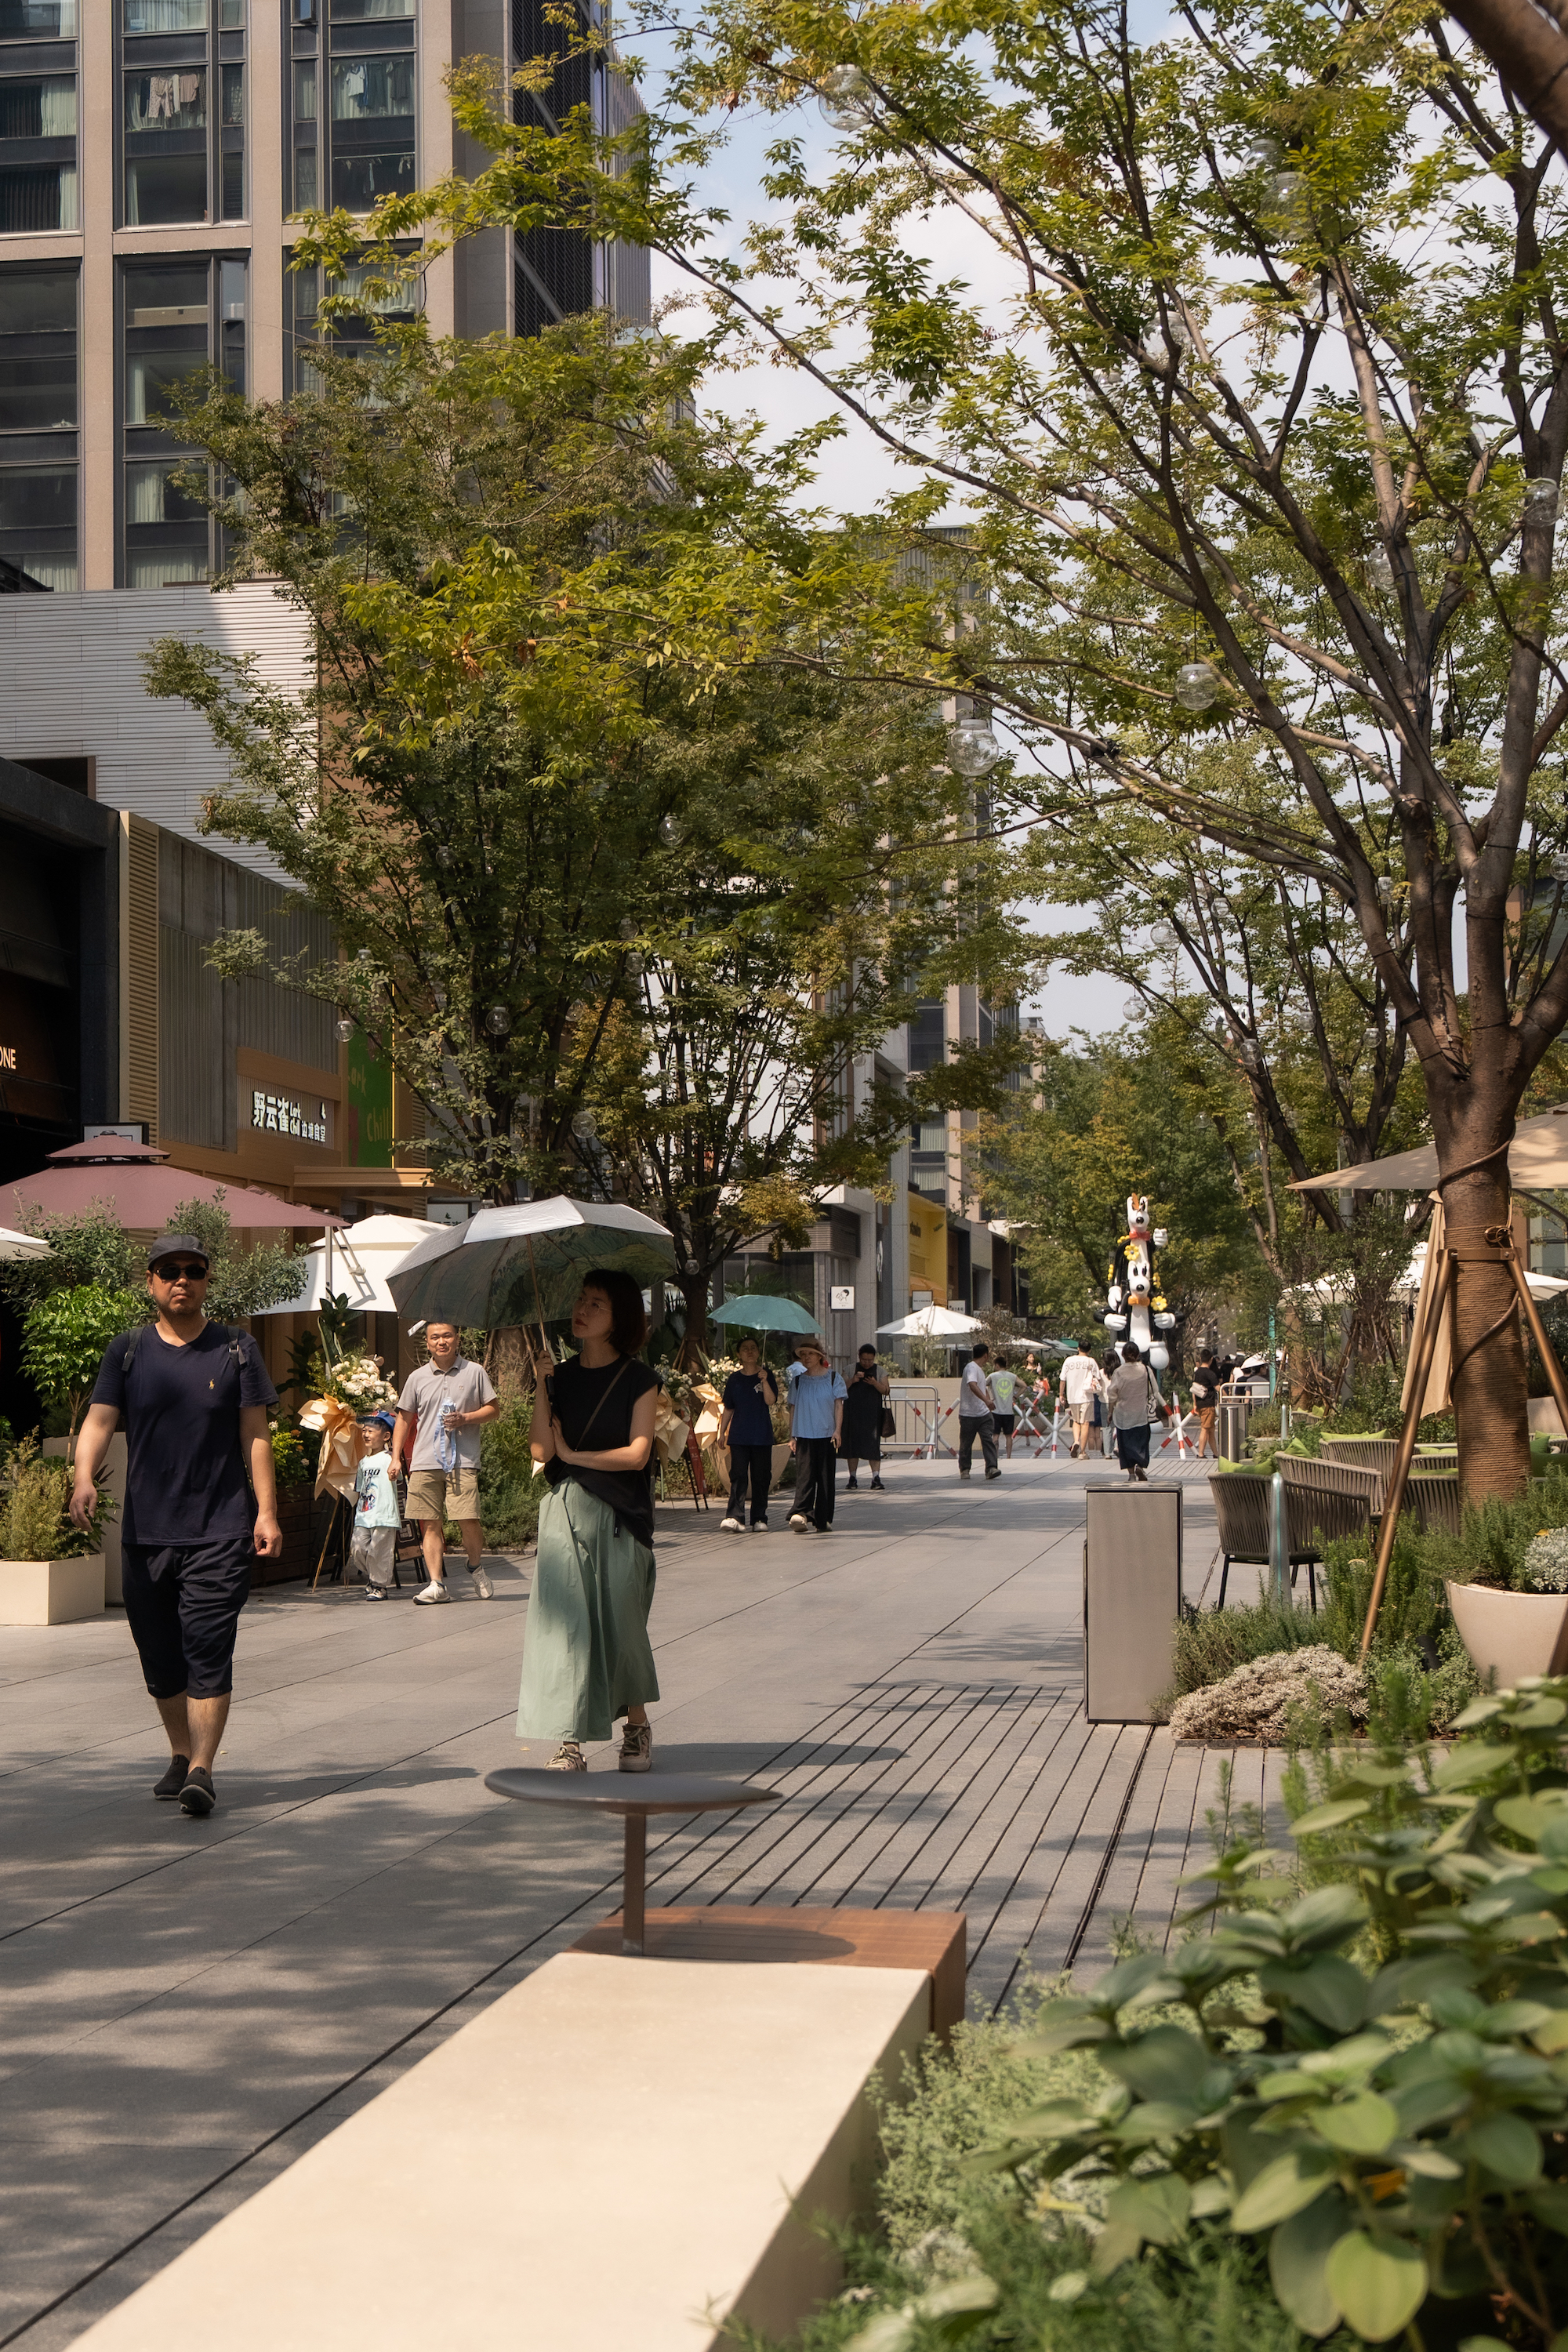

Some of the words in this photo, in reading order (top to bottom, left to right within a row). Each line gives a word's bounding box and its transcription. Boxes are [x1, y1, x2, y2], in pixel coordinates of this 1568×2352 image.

[348, 1065, 367, 1097] ark
[253, 1091, 289, 1132] 野云雀
[290, 1102, 301, 1119] Lark
[367, 1107, 389, 1142] Chill
